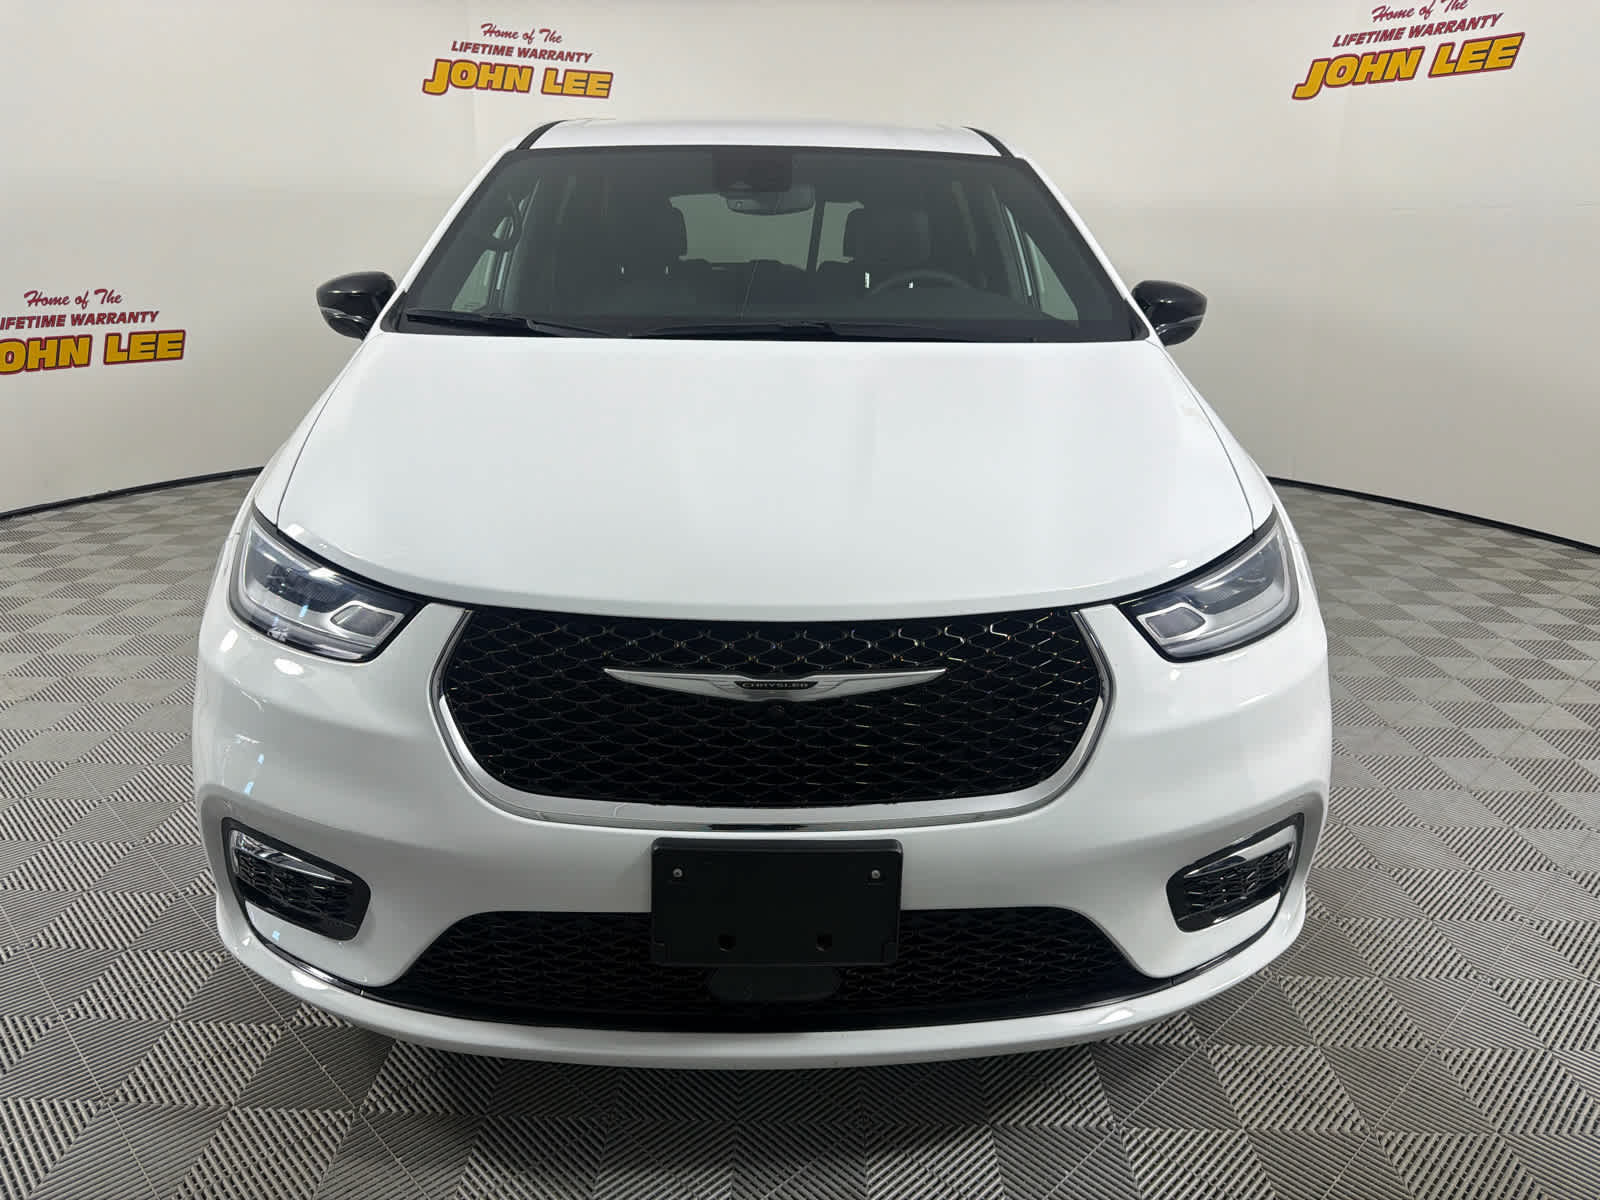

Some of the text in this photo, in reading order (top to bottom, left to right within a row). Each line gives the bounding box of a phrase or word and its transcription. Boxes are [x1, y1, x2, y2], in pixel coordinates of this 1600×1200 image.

[1371, 5, 1415, 23] Home
[1418, 0, 1436, 20] of
[480, 23, 563, 44] Home of The
[1332, 13, 1504, 48] LIFETIME WARRANTY
[451, 40, 593, 63] LIFETIME WARRANTY
[1292, 32, 1525, 100] JOHN LEE
[422, 58, 614, 99] JOHN LEE
[23, 288, 123, 310] Home of The
[0, 311, 160, 330] IFETIME WARRANTY
[0, 329, 186, 375] OHN LEE
